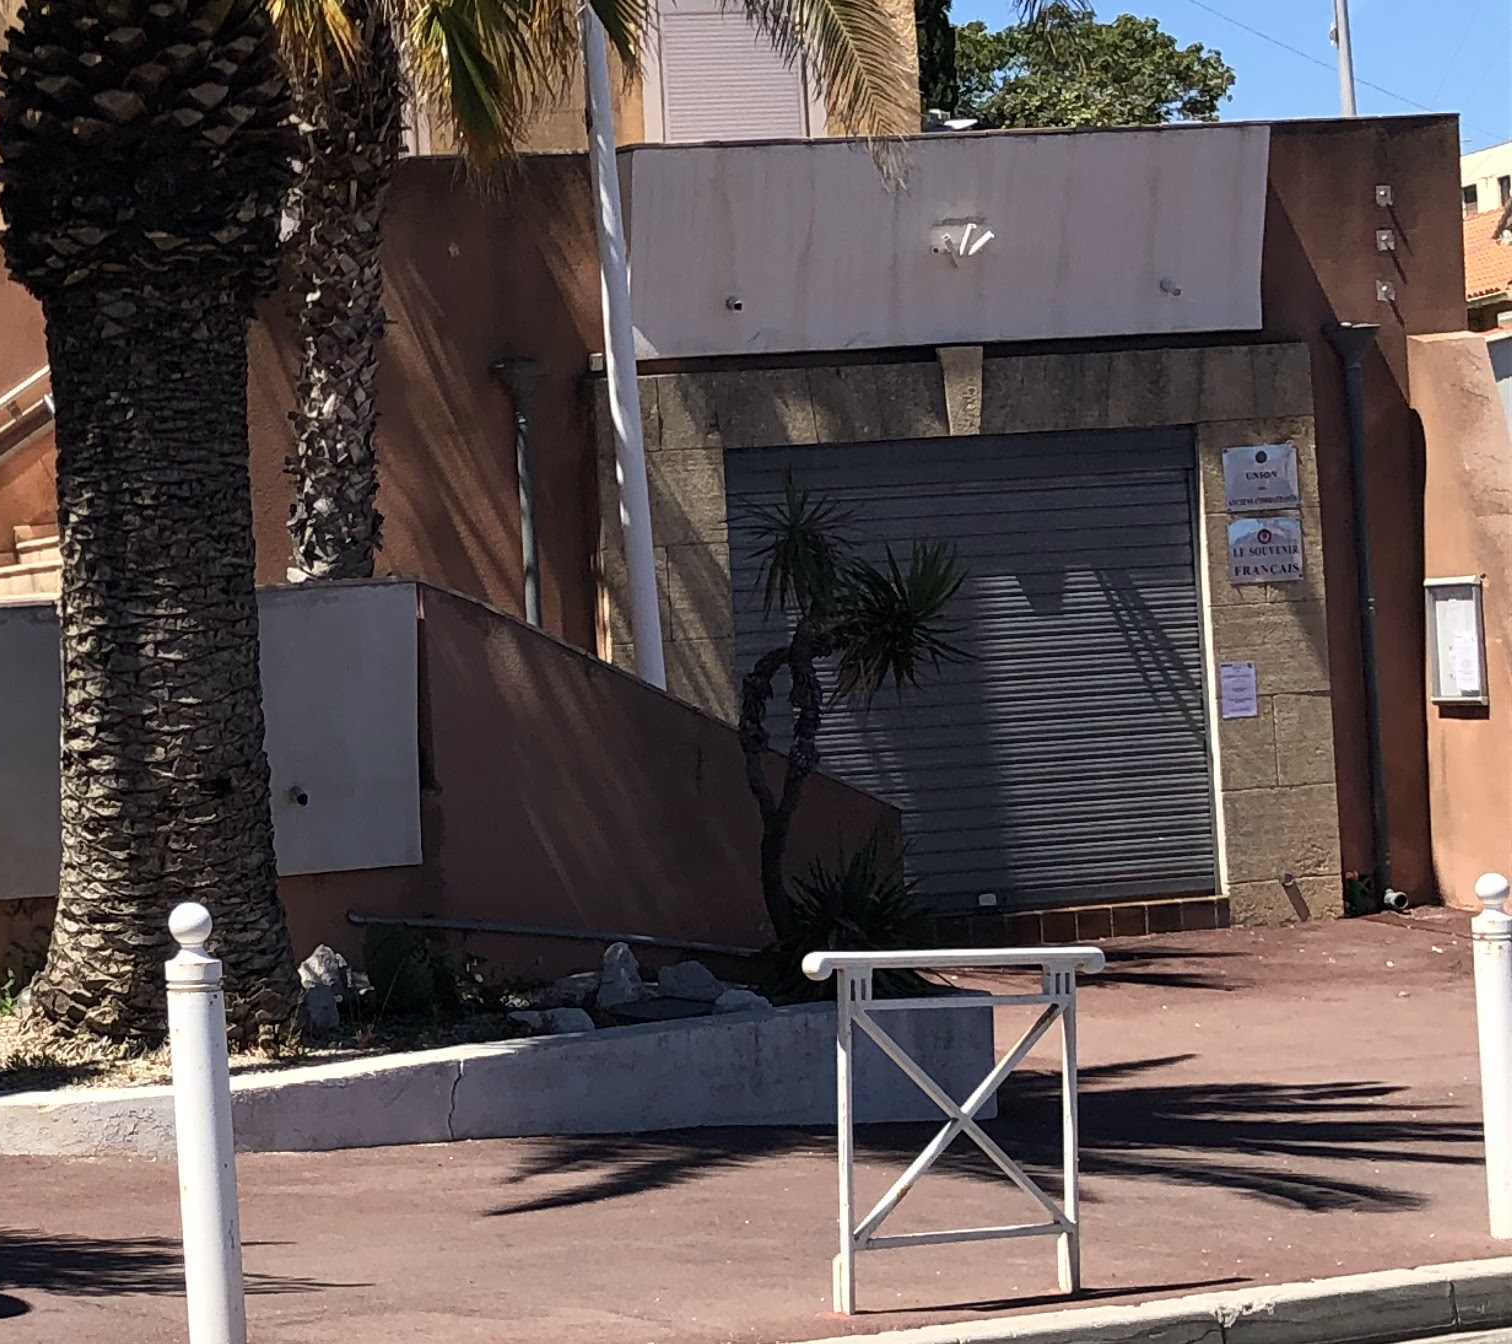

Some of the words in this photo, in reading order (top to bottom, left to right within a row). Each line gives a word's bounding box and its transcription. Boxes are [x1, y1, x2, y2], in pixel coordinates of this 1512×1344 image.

[1245, 471, 1278, 481] UNION
[1233, 547, 1245, 557] LE
[1248, 544, 1299, 556] SOUVENIR
[1234, 563, 1301, 576] FRANÇAIS
